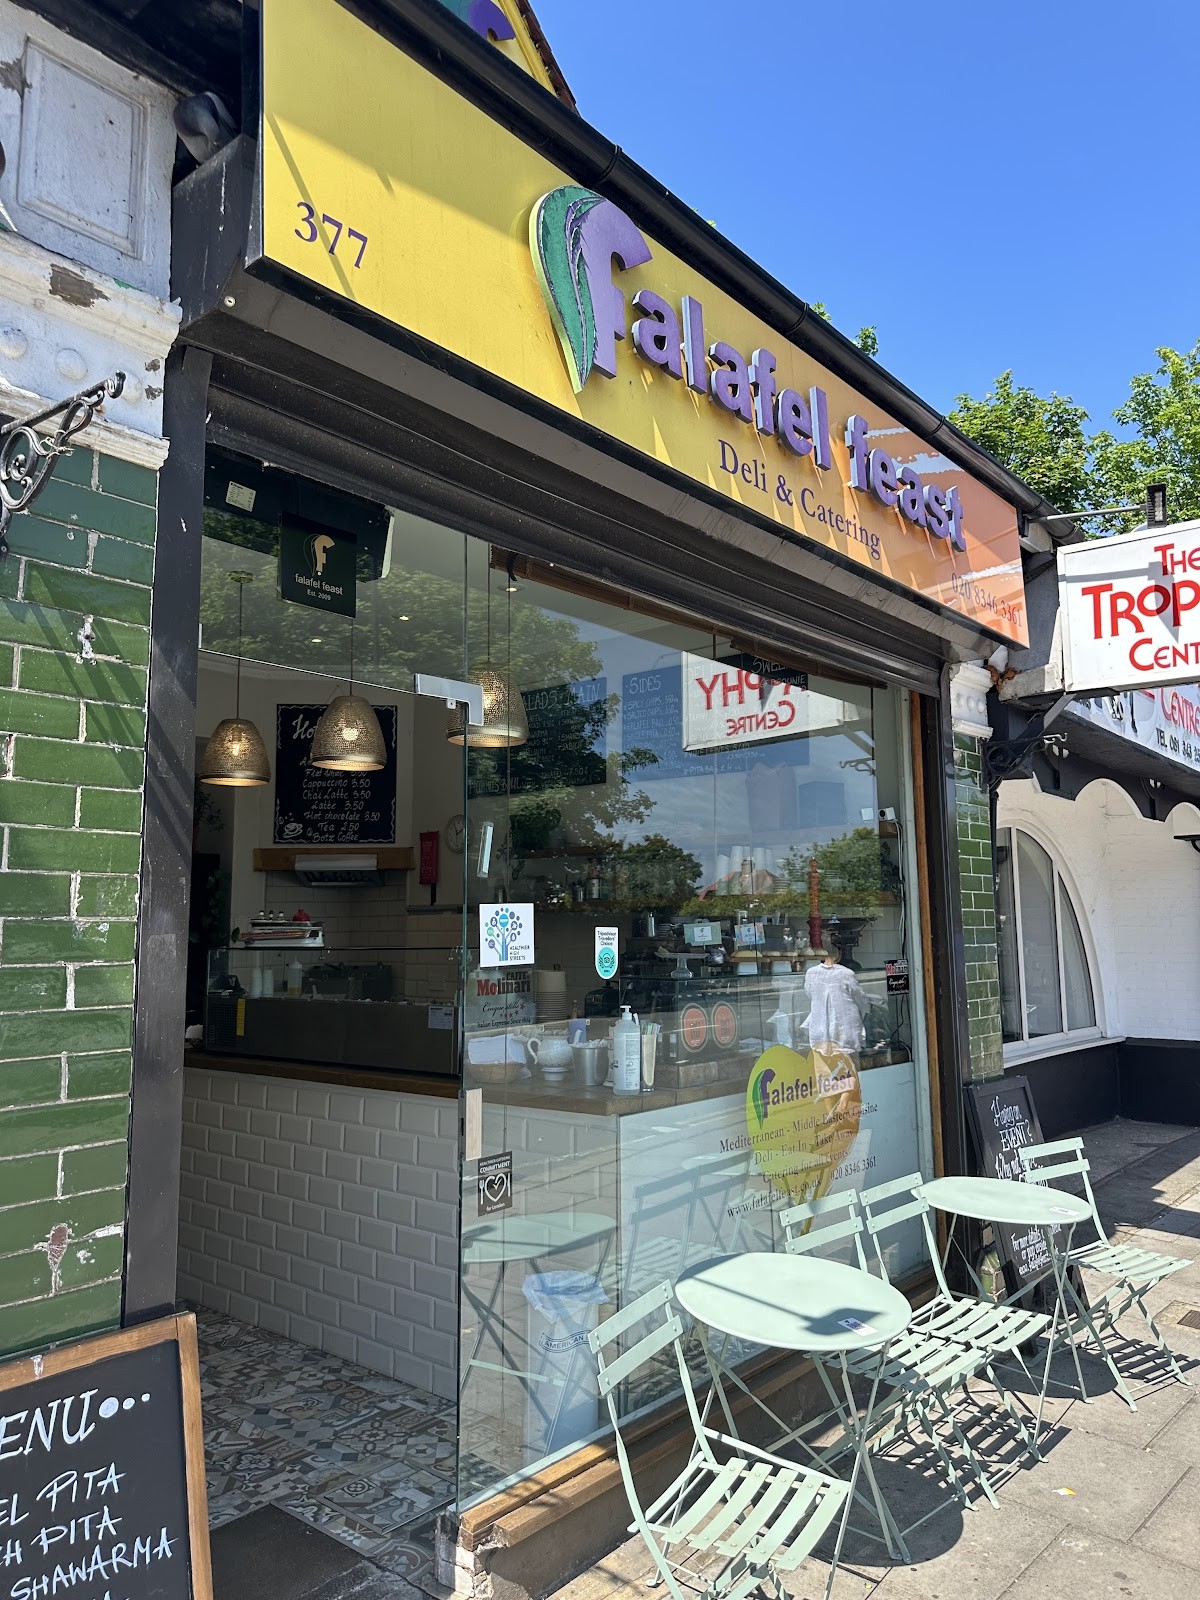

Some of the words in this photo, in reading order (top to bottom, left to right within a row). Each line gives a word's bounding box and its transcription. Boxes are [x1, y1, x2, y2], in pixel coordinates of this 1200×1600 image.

[294, 201, 368, 269] 377
[530, 185, 831, 471] falafel
[845, 414, 966, 553] feast
[717, 439, 767, 493] Deli
[775, 475, 794, 506] &
[800, 486, 881, 560] Catering
[295, 573, 321, 589] falafel
[322, 581, 343, 595] feast
[951, 572, 971, 600] 020
[974, 585, 998, 615] 8346
[1001, 599, 1022, 628] 3361
[630, 674, 662, 694] SIDES
[302, 778, 348, 792] Cappuccino
[351, 778, 371, 789] 3.50
[302, 790, 323, 800] Chai
[323, 787, 349, 800] Latte
[311, 801, 337, 811] Latte
[345, 800, 365, 811] 3.50
[304, 811, 323, 821] Hot
[325, 810, 361, 822] chocolate
[364, 811, 381, 822] 3.50
[317, 821, 335, 832] Tea
[336, 831, 359, 843] Coffee
[477, 977, 531, 997] Molinari
[758, 1068, 813, 1120] falafel
[818, 1069, 853, 1095] feast
[719, 1127, 785, 1154] Mediterranean
[792, 1115, 820, 1134] Middle
[754, 1150, 773, 1165] Deli
[781, 1143, 796, 1158] Eat
[798, 1140, 808, 1155] In
[815, 1132, 834, 1148] Take
[479, 1160, 511, 1174] COMMITMENT
[801, 1159, 812, 1175] for
[830, 1168, 843, 1182] 020
[544, 1335, 584, 1350] AMERICAN
[36, 1462, 127, 1512] PITA
[30, 1505, 123, 1554] PITA
[10, 1527, 180, 1600] SHAWARMA
